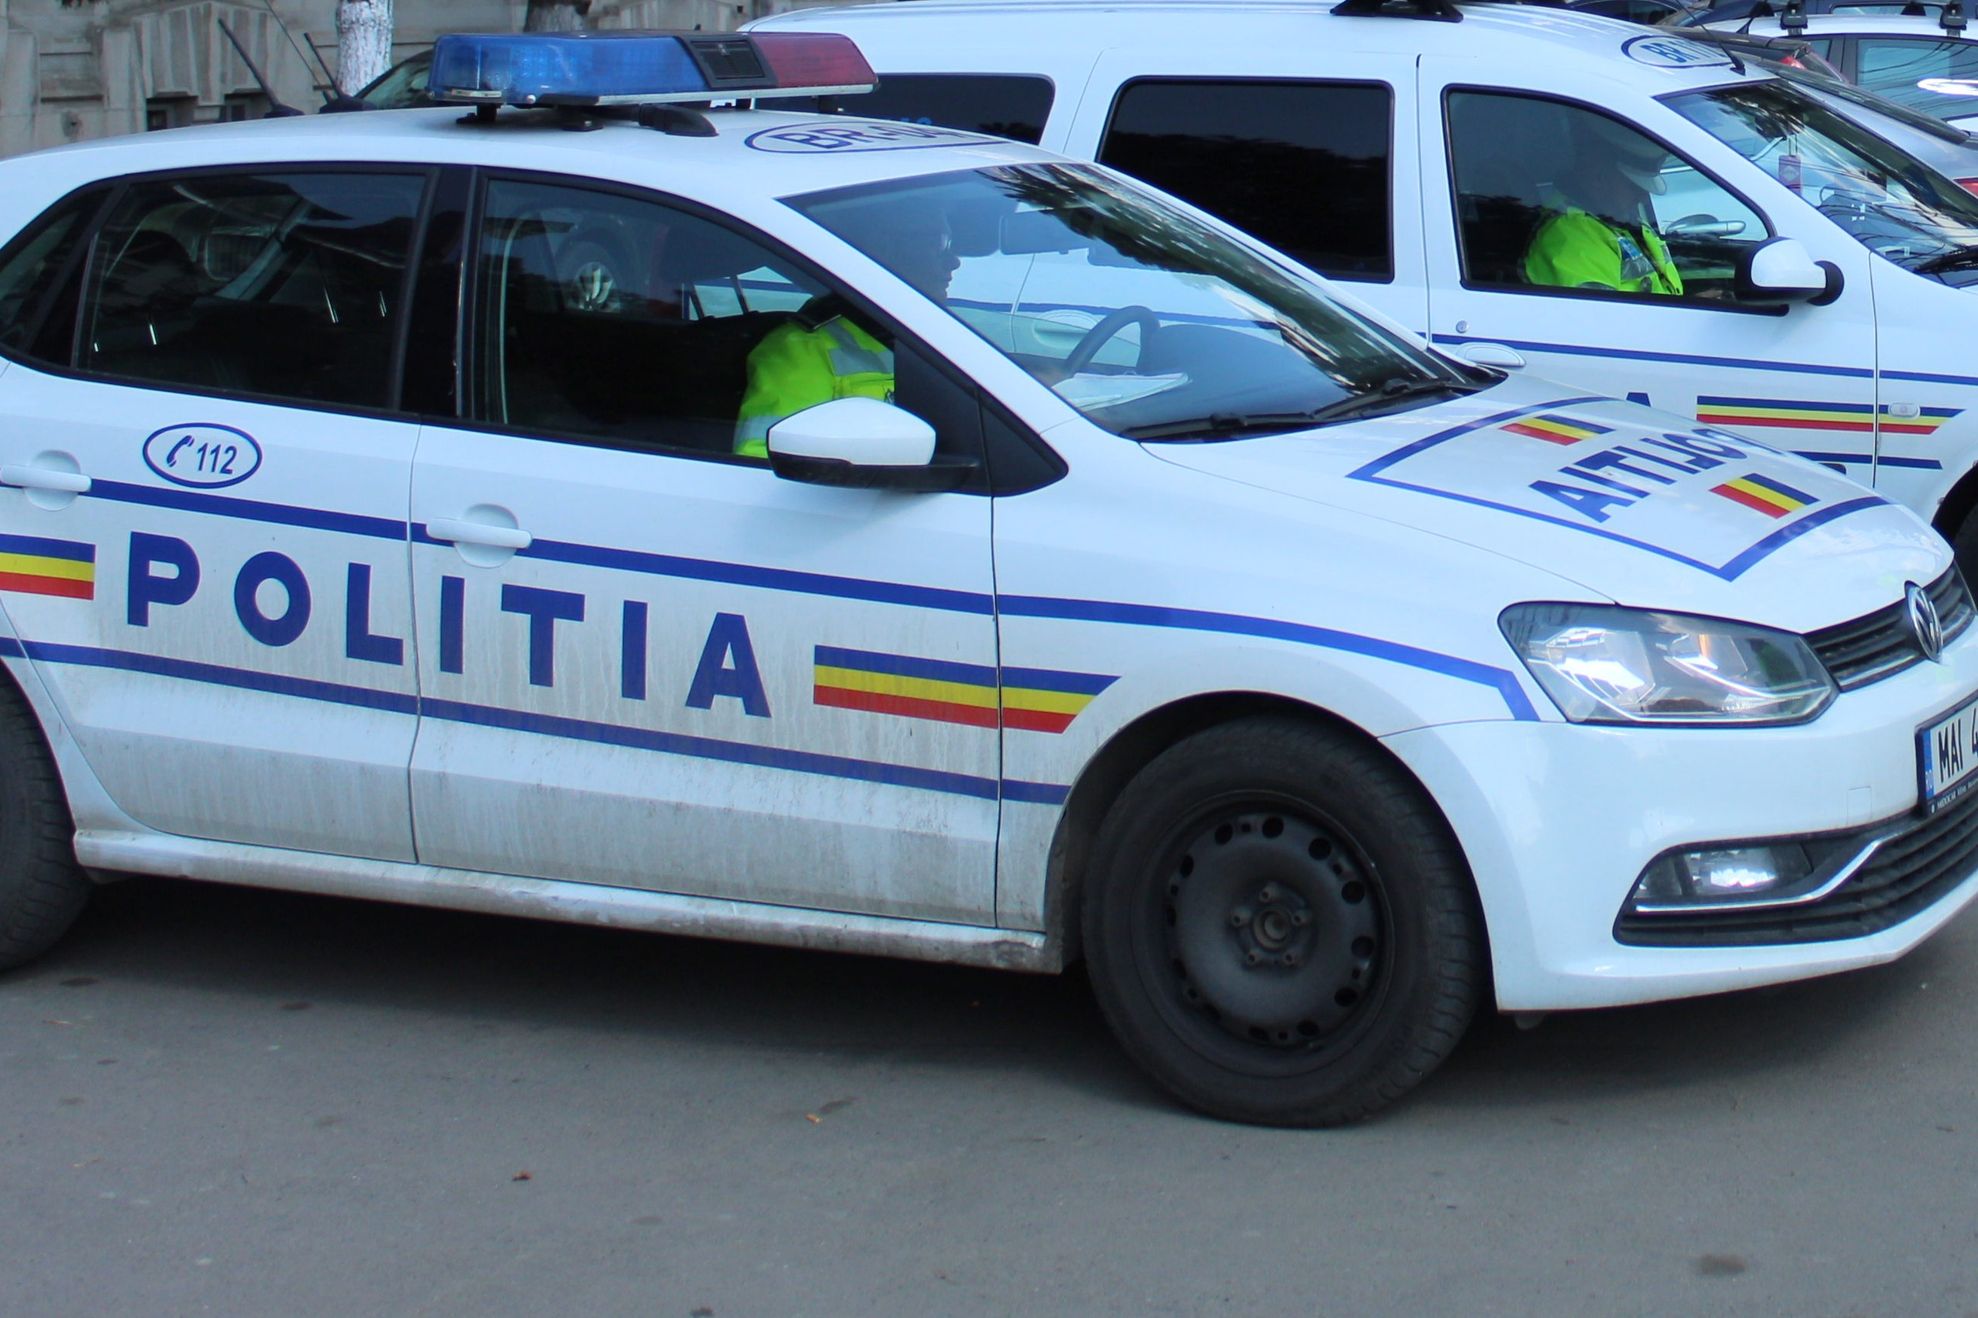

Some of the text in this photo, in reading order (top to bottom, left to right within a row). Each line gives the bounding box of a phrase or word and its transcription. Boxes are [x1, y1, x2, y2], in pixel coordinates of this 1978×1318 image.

[197, 442, 238, 475] 112
[127, 531, 771, 718] POLITIA
[1938, 718, 1963, 783] MAI
